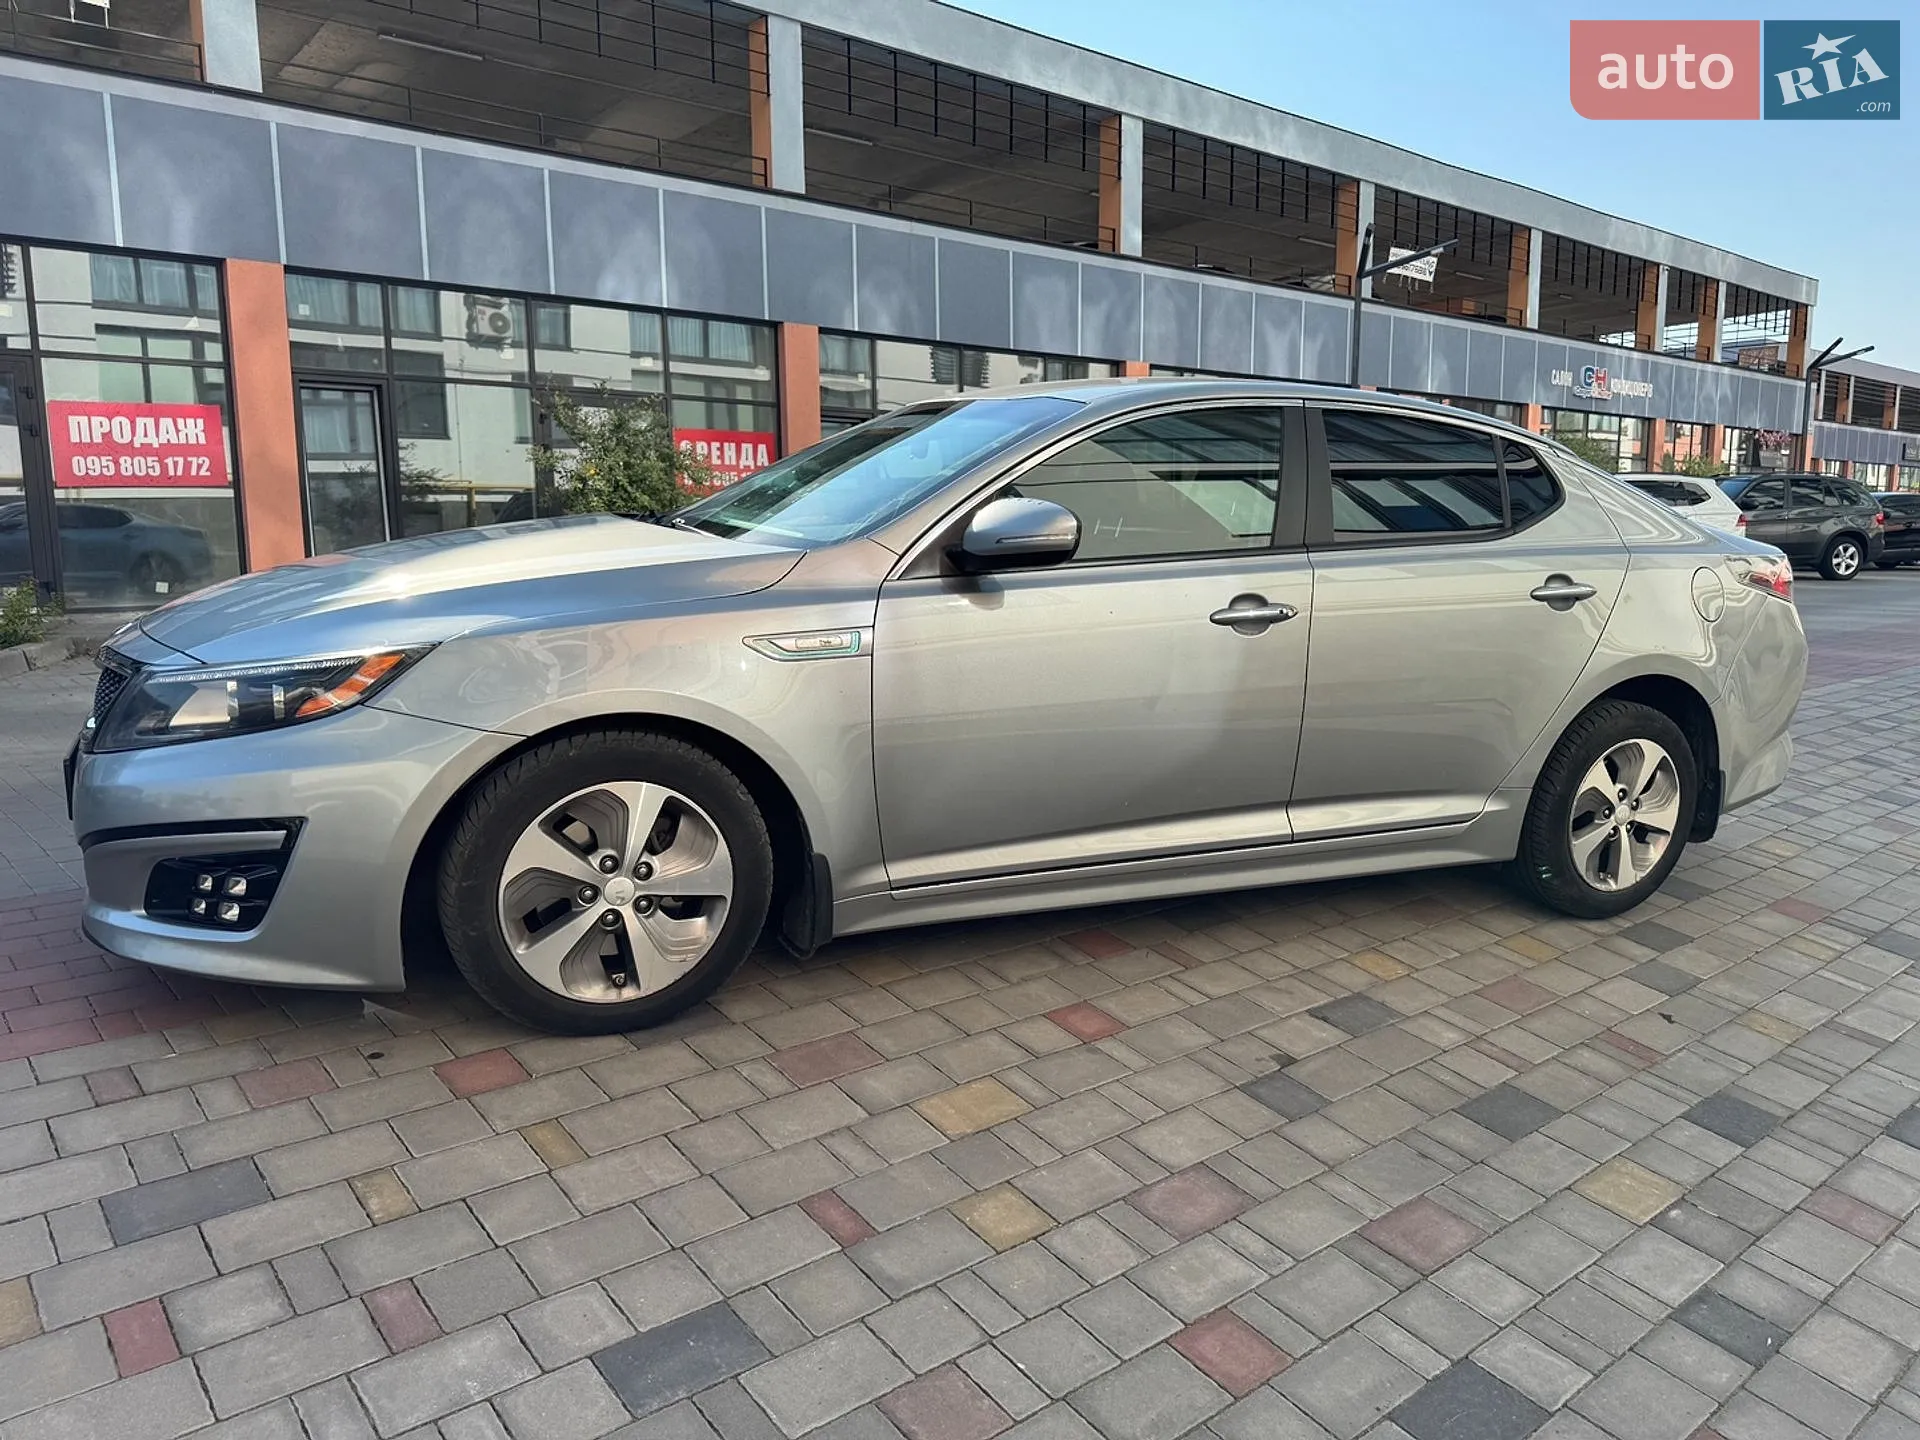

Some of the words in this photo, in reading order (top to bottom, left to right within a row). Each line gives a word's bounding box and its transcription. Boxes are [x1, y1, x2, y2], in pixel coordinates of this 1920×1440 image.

[68, 415, 206, 448] ПРОДАЖ
[71, 456, 115, 476] 095
[119, 456, 161, 476] 805
[164, 456, 184, 476] 17
[187, 456, 211, 476] 72
